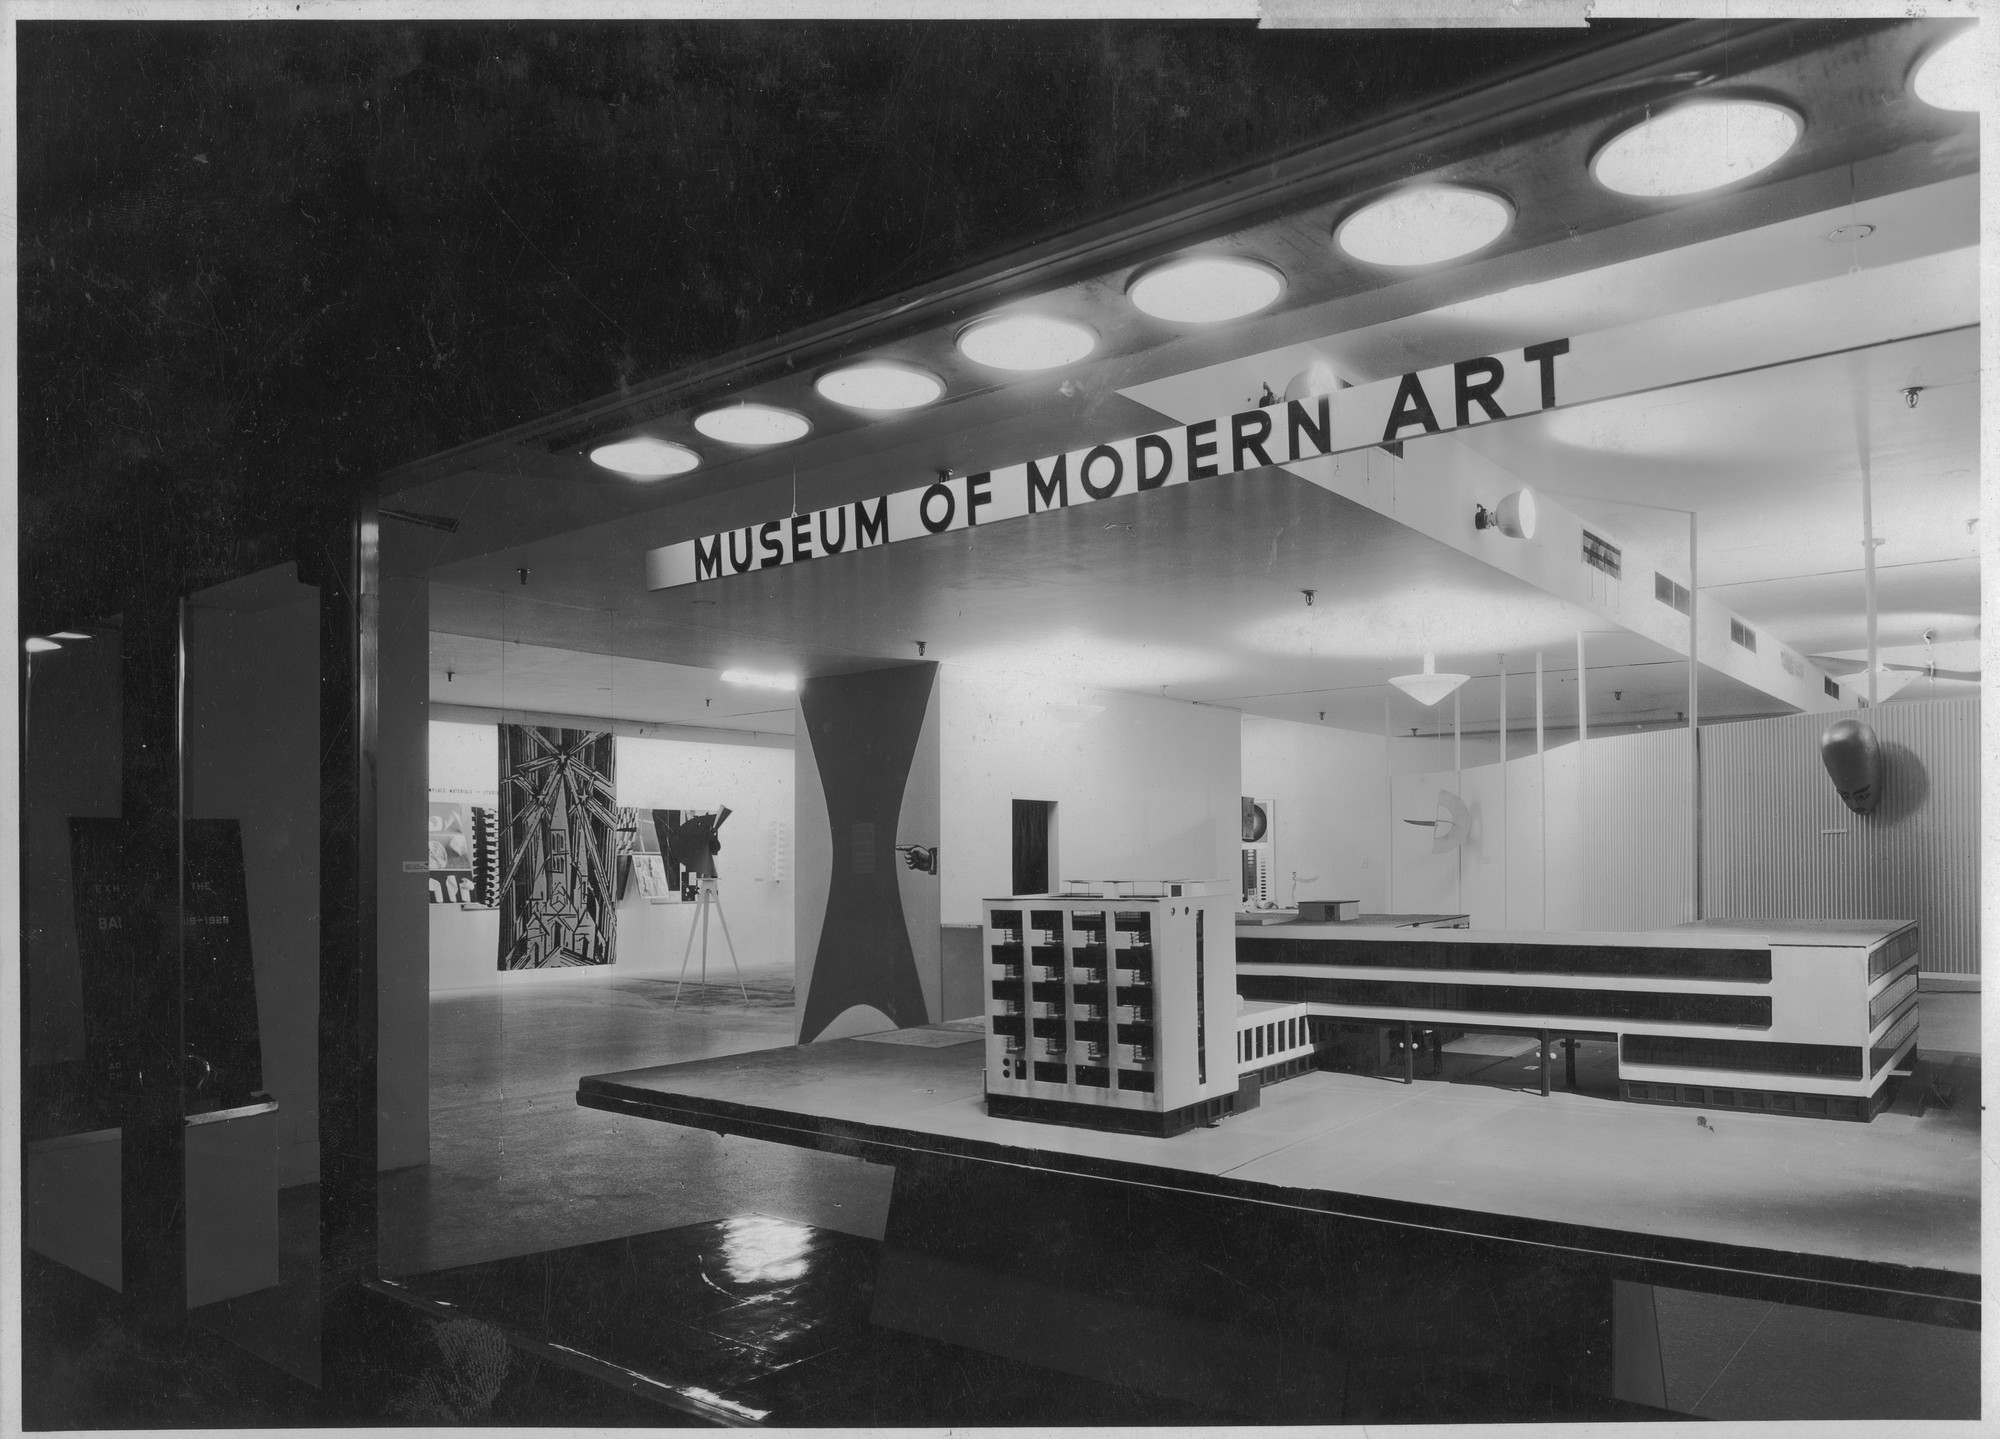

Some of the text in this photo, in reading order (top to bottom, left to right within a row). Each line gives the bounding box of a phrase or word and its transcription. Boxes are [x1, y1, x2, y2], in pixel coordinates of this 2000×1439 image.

[694, 337, 1570, 582] MUSEUM OF MODERN ART
[190, 881, 211, 890] THE
[183, 915, 229, 926] 19-1928
